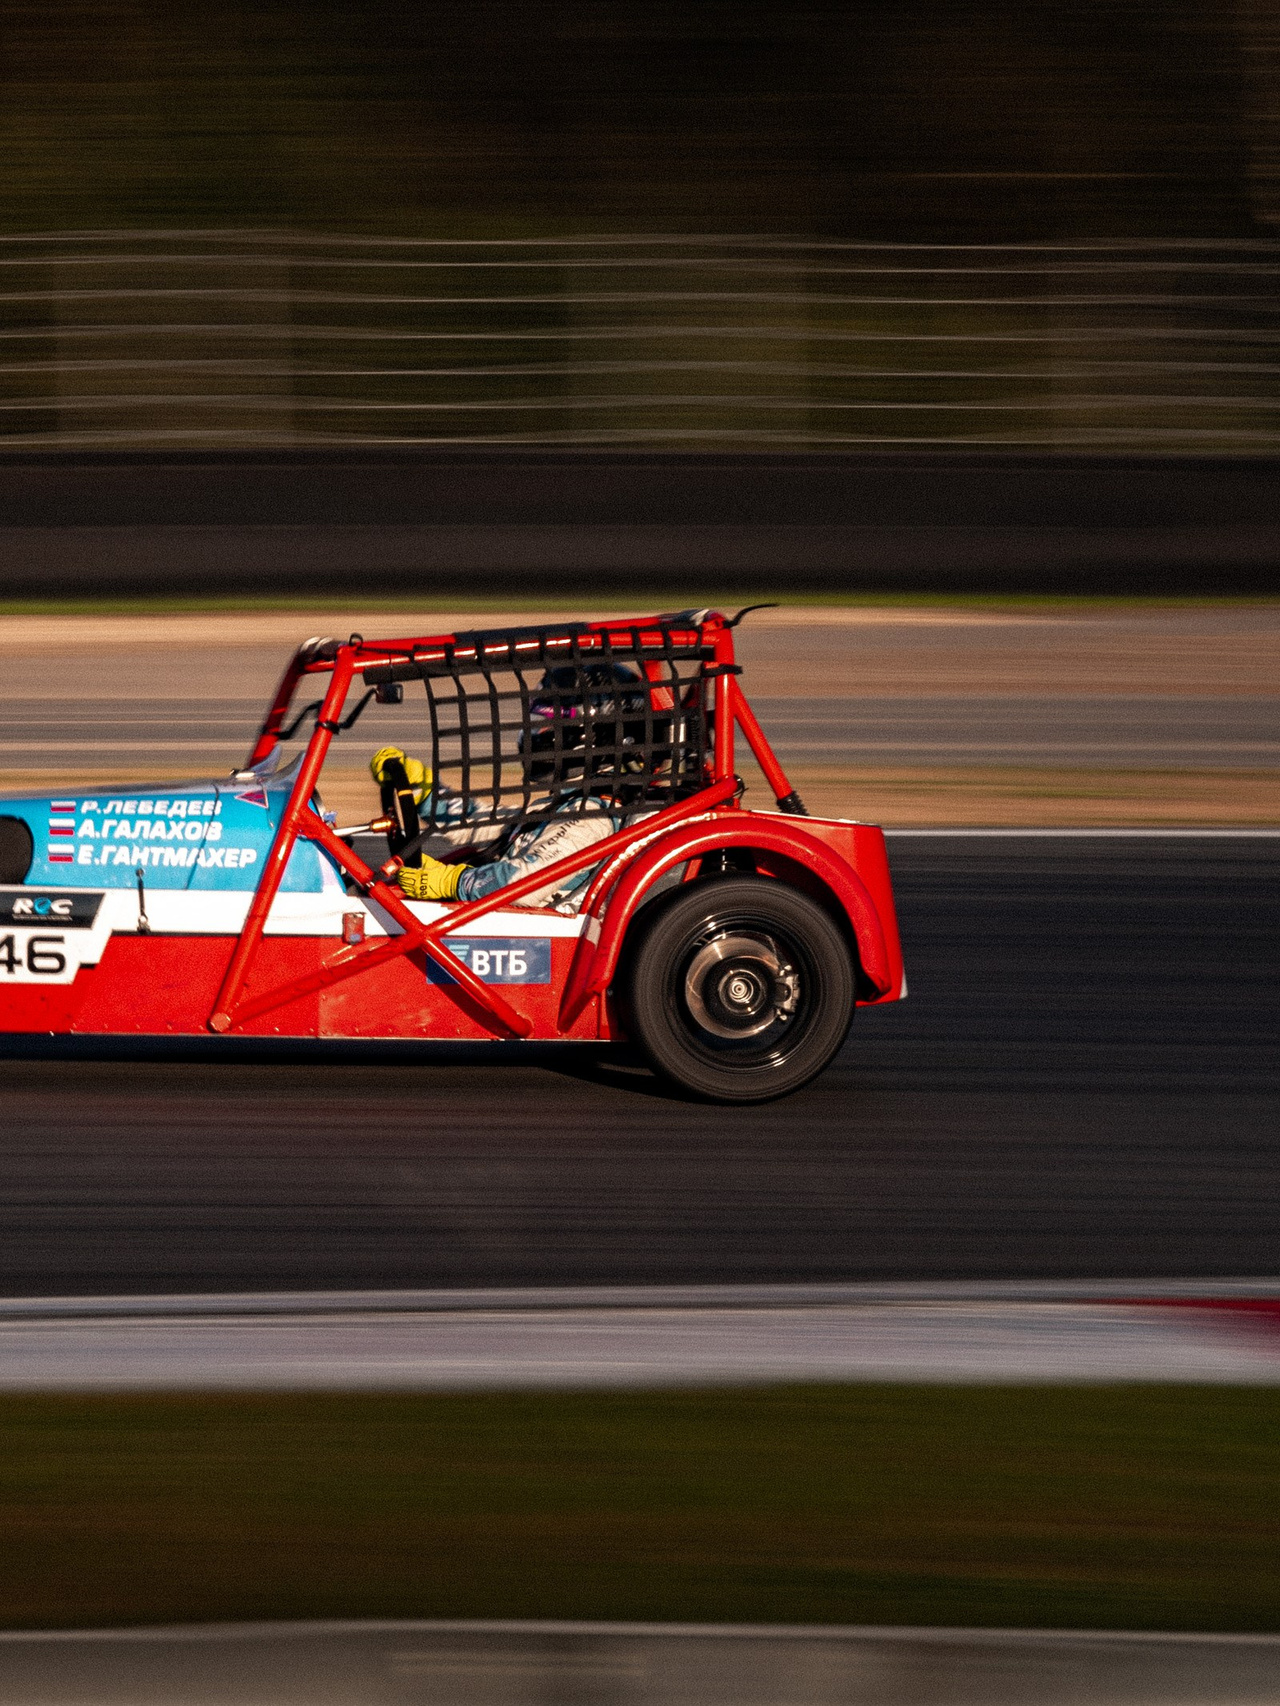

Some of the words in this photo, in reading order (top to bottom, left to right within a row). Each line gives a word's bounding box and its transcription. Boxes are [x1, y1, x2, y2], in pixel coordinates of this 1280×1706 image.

[80, 800, 223, 818] Р.ЛЕБЕДЕВ
[77, 818, 223, 841] А.ГАЛАХОВ
[77, 844, 258, 868] Е.ГАНТМАХЕР
[472, 950, 528, 976] ВТБ
